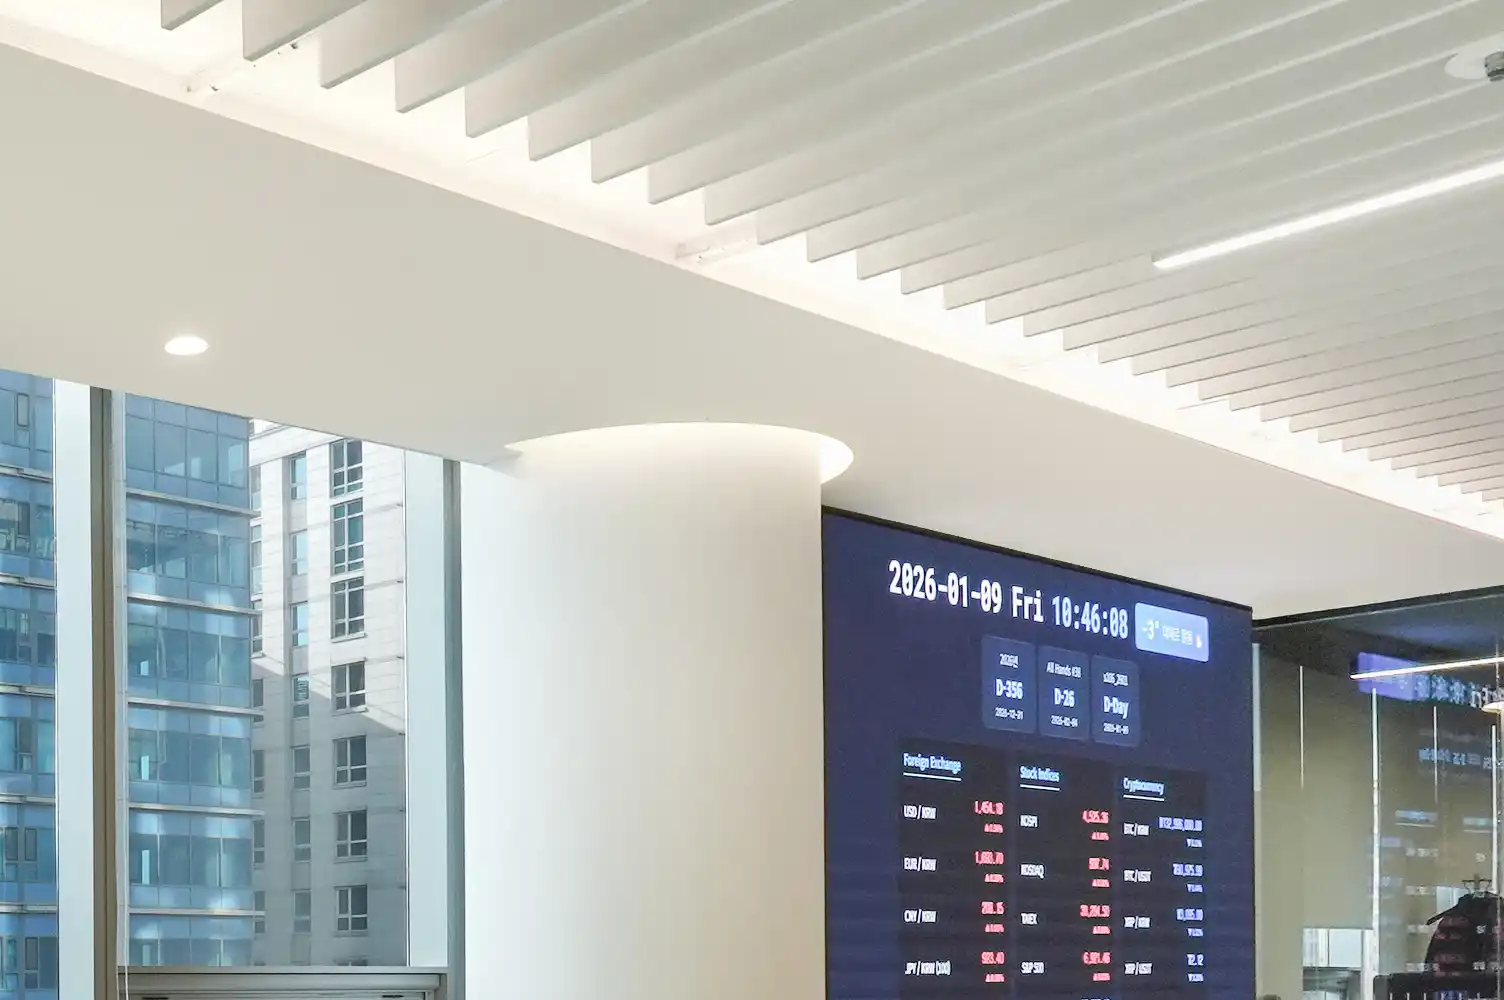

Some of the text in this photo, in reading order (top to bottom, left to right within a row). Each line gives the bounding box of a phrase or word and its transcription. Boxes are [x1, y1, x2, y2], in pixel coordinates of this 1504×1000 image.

[888, 559, 1129, 639] 2026-01-09 Fri 10:46:08
[996, 679, 1023, 699] D-356
[1054, 688, 1075, 707] D-26
[1103, 696, 1129, 719] D-Day
[903, 753, 962, 774] Foreign Exchange
[1020, 765, 1060, 782] Stock Indices
[903, 805, 917, 818] USD
